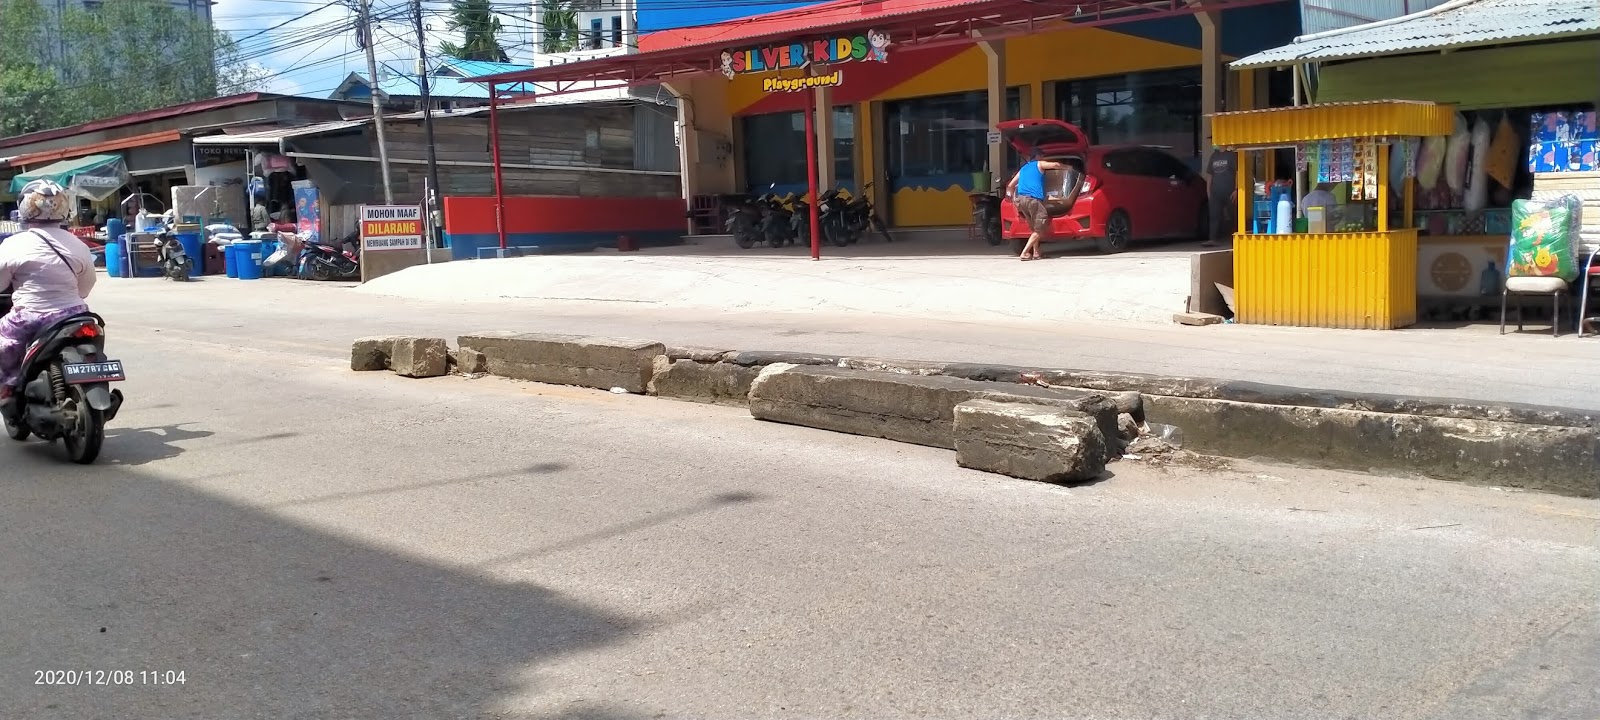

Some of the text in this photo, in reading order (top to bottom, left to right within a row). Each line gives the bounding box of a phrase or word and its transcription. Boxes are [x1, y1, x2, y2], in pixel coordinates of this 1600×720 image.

[732, 35, 868, 73] SILVER KIDS
[763, 71, 840, 92] Playground
[367, 208, 417, 218] MOHON MAAF
[367, 222, 416, 235] DILARANG
[366, 239, 388, 247] MEMBUANG
[389, 238, 405, 246] SAMPAH
[67, 366, 80, 374] BM
